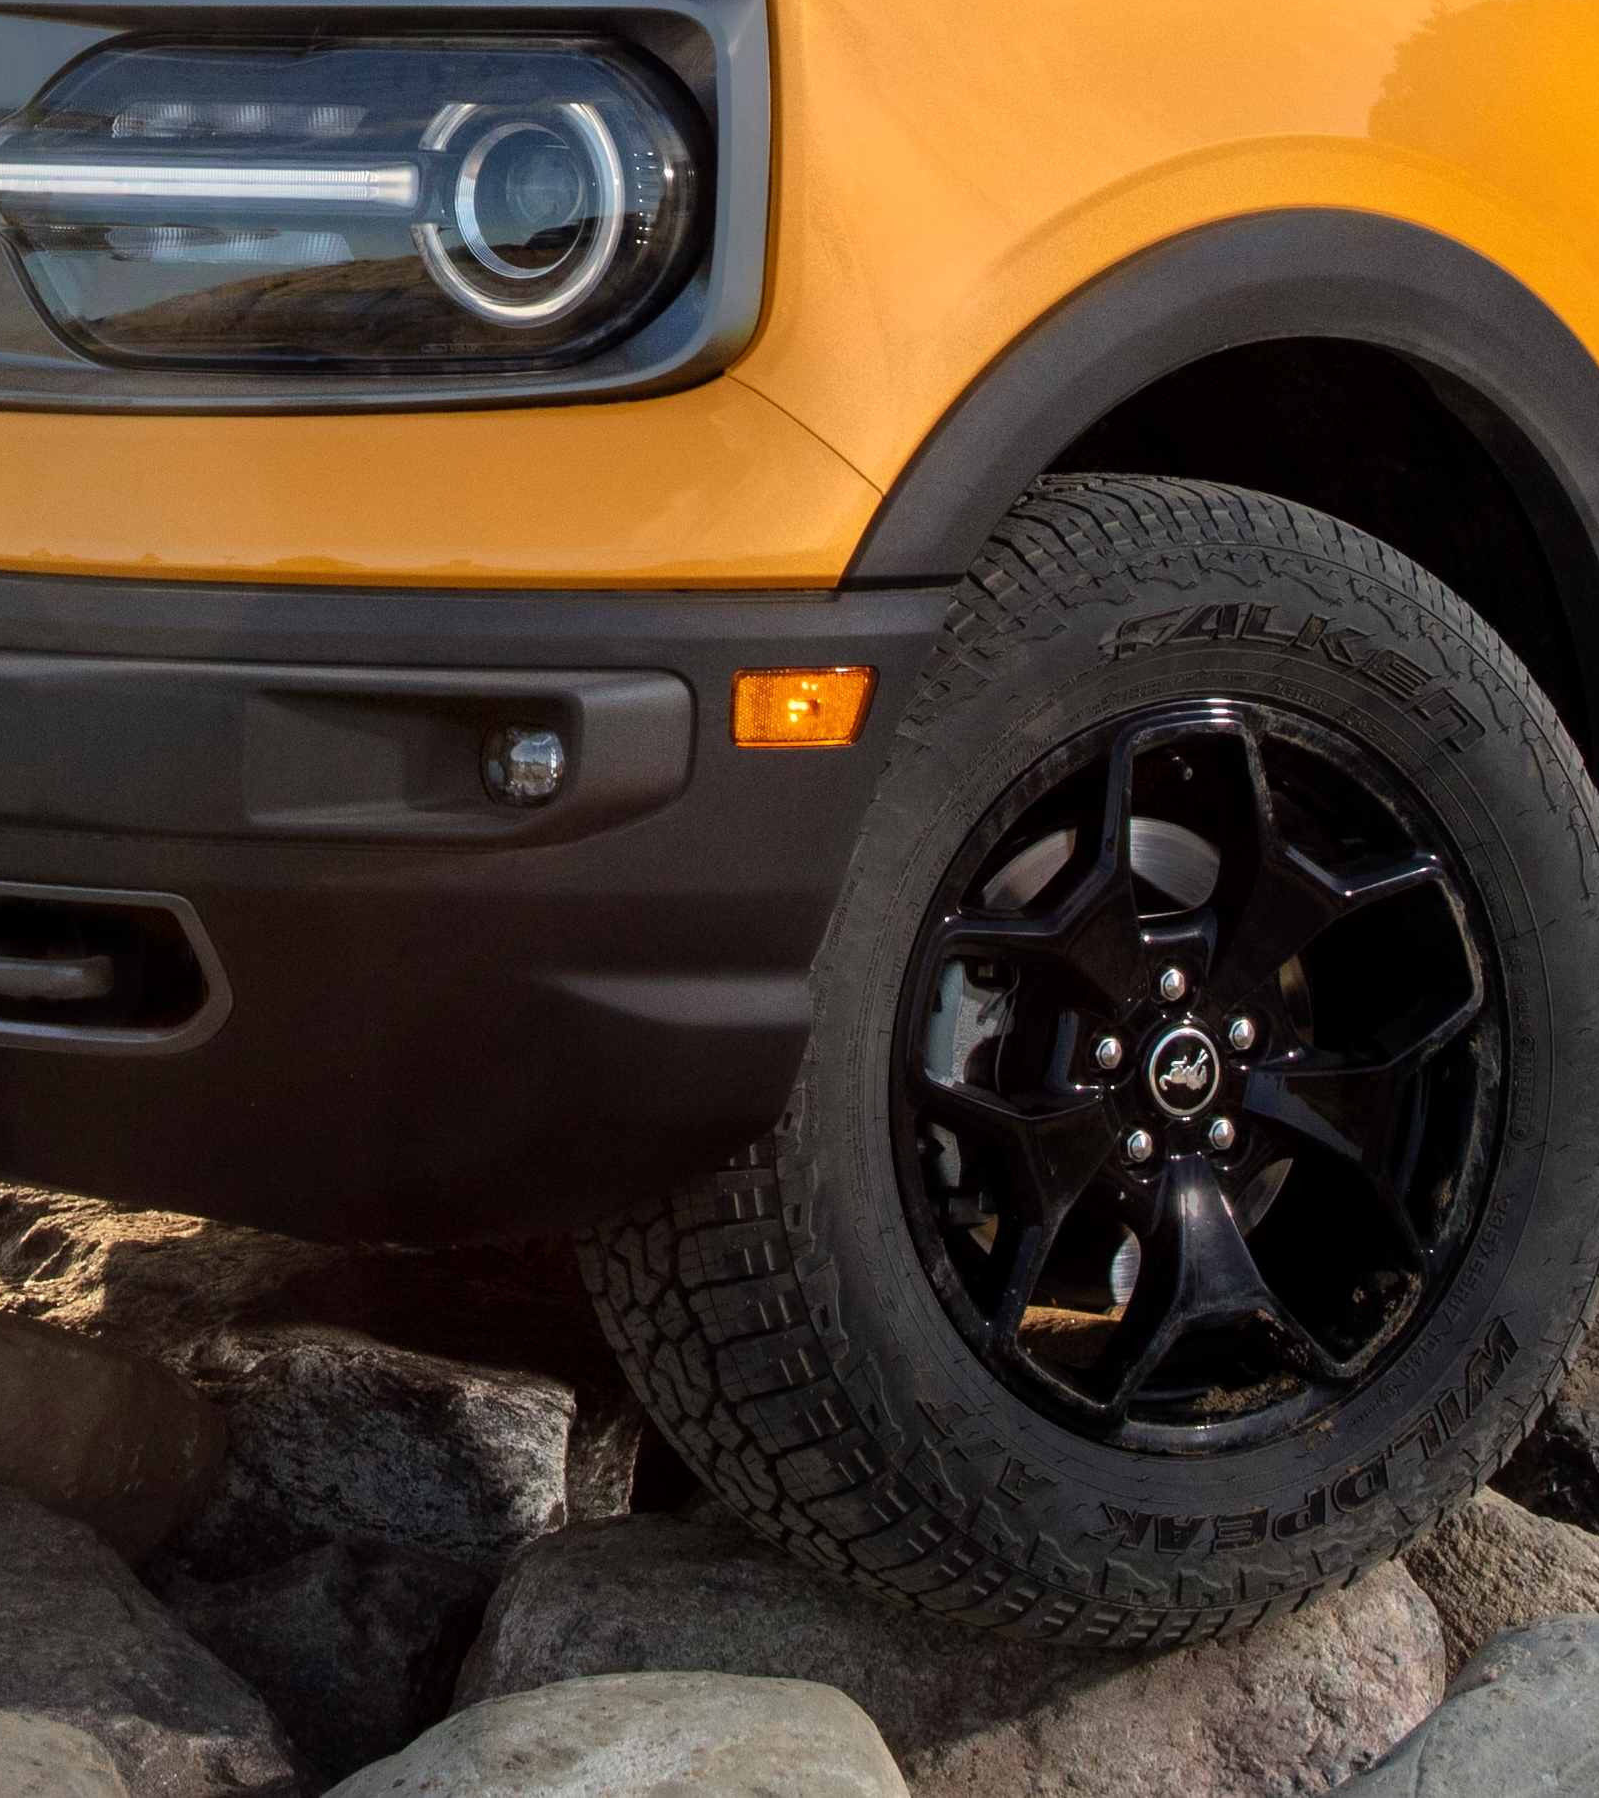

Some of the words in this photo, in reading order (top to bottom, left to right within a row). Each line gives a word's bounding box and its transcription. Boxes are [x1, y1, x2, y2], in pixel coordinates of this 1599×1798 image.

[1098, 601, 1486, 753] FALKEN
[828, 879, 859, 952] TEMPERATURE
[1087, 1319, 1520, 1553] WILDPEAK
